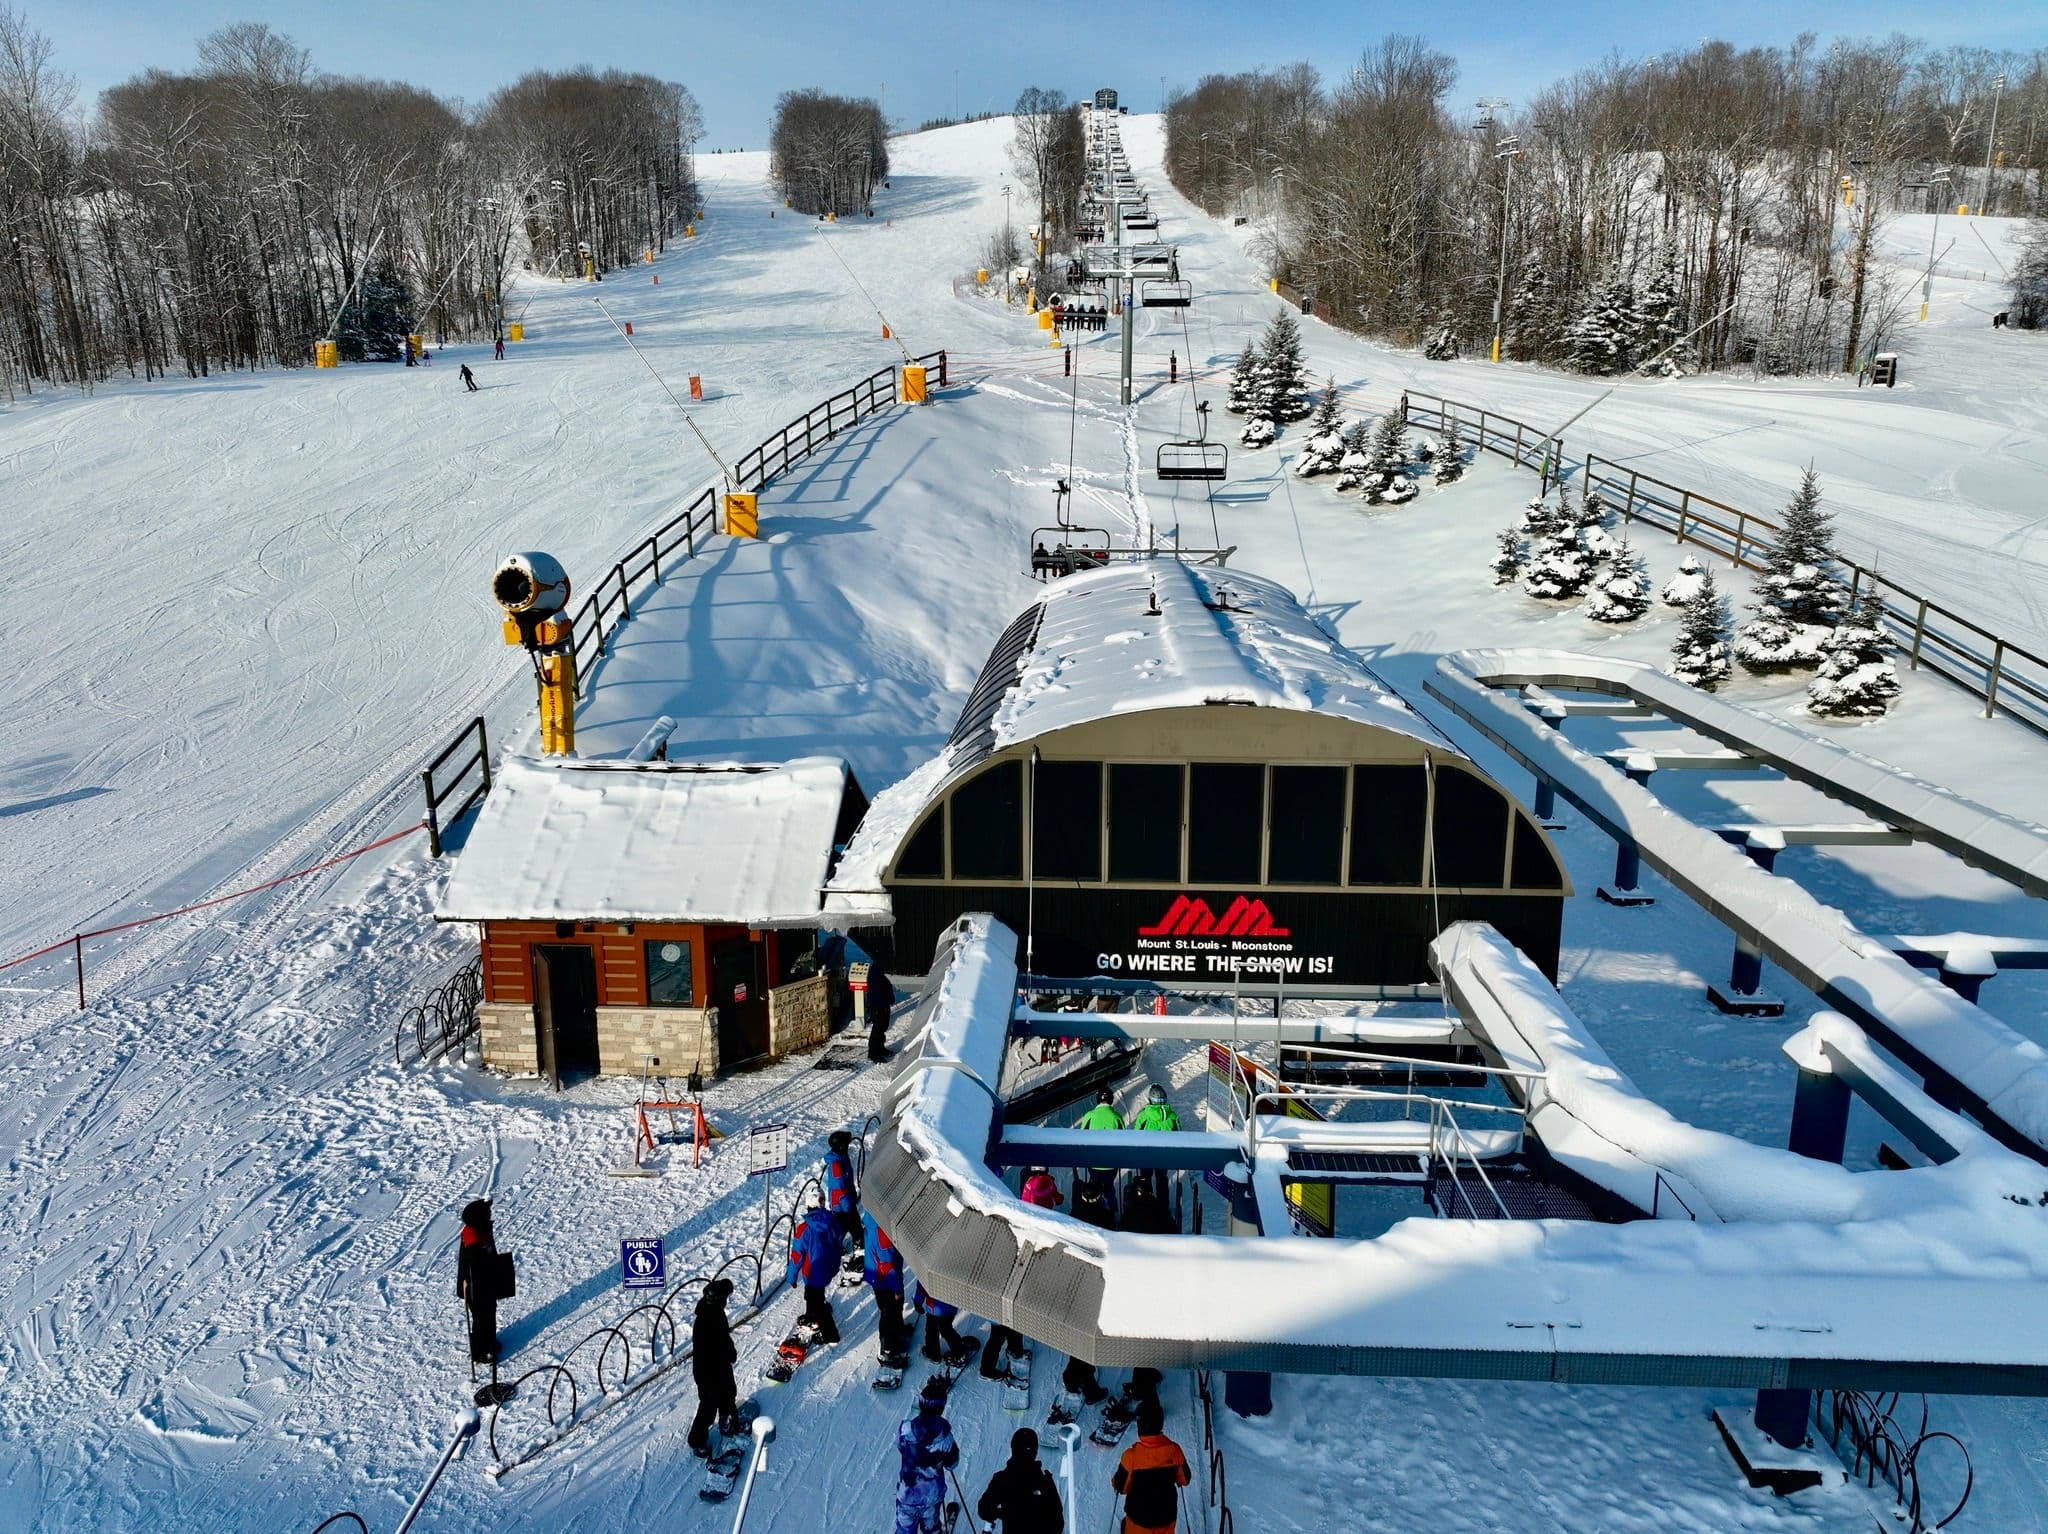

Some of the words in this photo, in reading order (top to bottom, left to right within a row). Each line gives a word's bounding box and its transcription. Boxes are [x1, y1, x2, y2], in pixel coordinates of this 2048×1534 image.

[1137, 939, 1171, 949] Mount
[1231, 941, 1293, 951] Moonstone
[1096, 953, 1123, 970] GO
[1127, 954, 1196, 972] WHERE
[1205, 955, 1242, 972] THE
[1245, 956, 1304, 973] SNOW
[1308, 956, 1334, 974] IS!
[627, 1241, 658, 1249] PUBLIC
